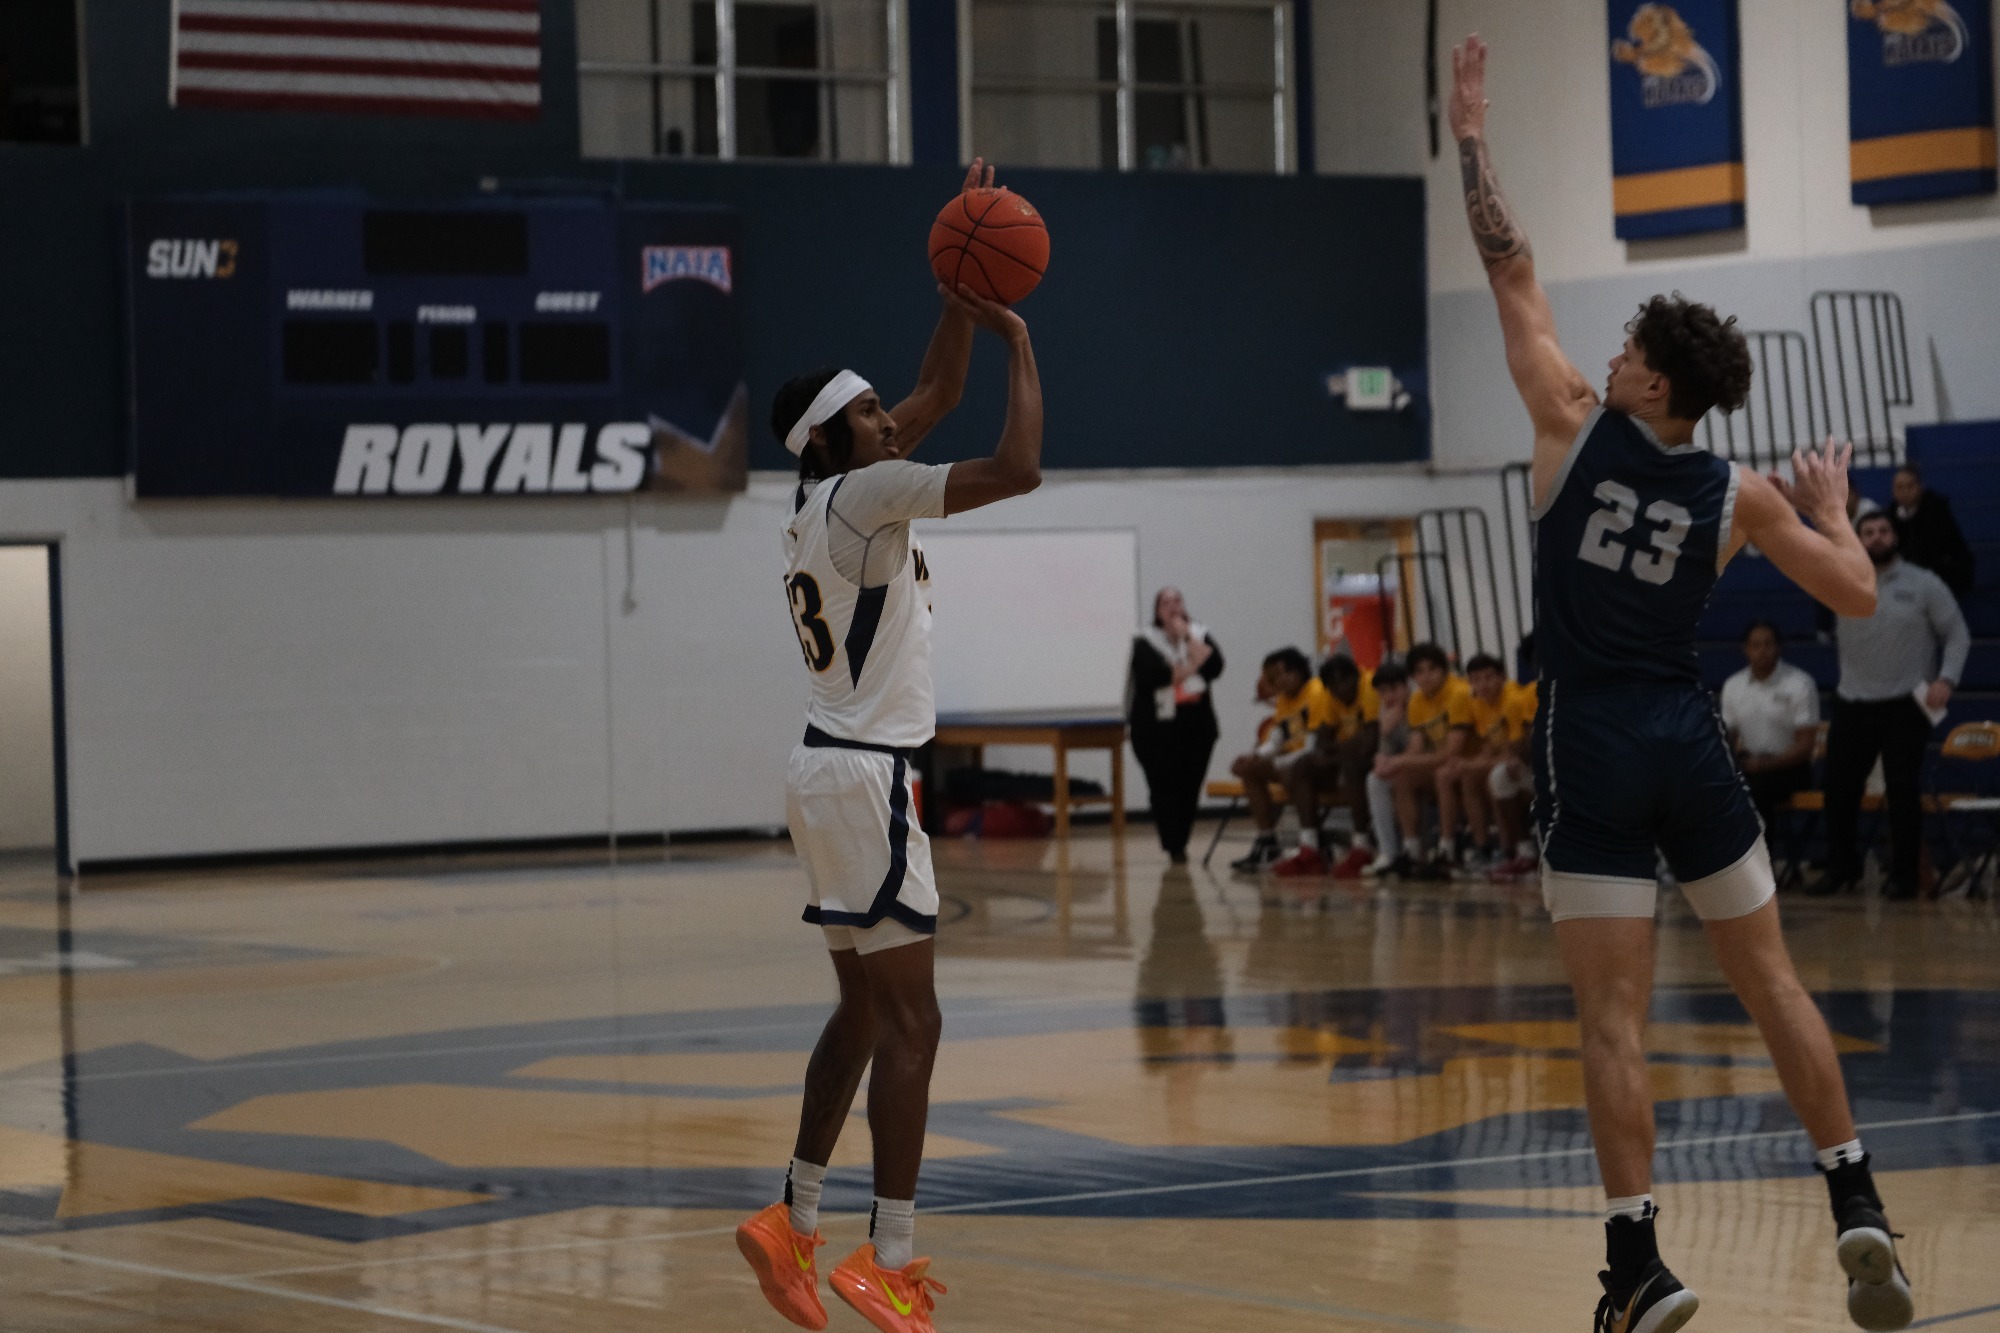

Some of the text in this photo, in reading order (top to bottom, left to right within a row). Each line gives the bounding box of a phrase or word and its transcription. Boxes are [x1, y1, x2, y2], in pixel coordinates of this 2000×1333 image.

[646, 248, 727, 283] NAIA
[286, 289, 374, 311] WARNER
[535, 290, 601, 312] GUEST
[332, 422, 652, 494] ROYALS
[1577, 478, 1693, 586] 23
